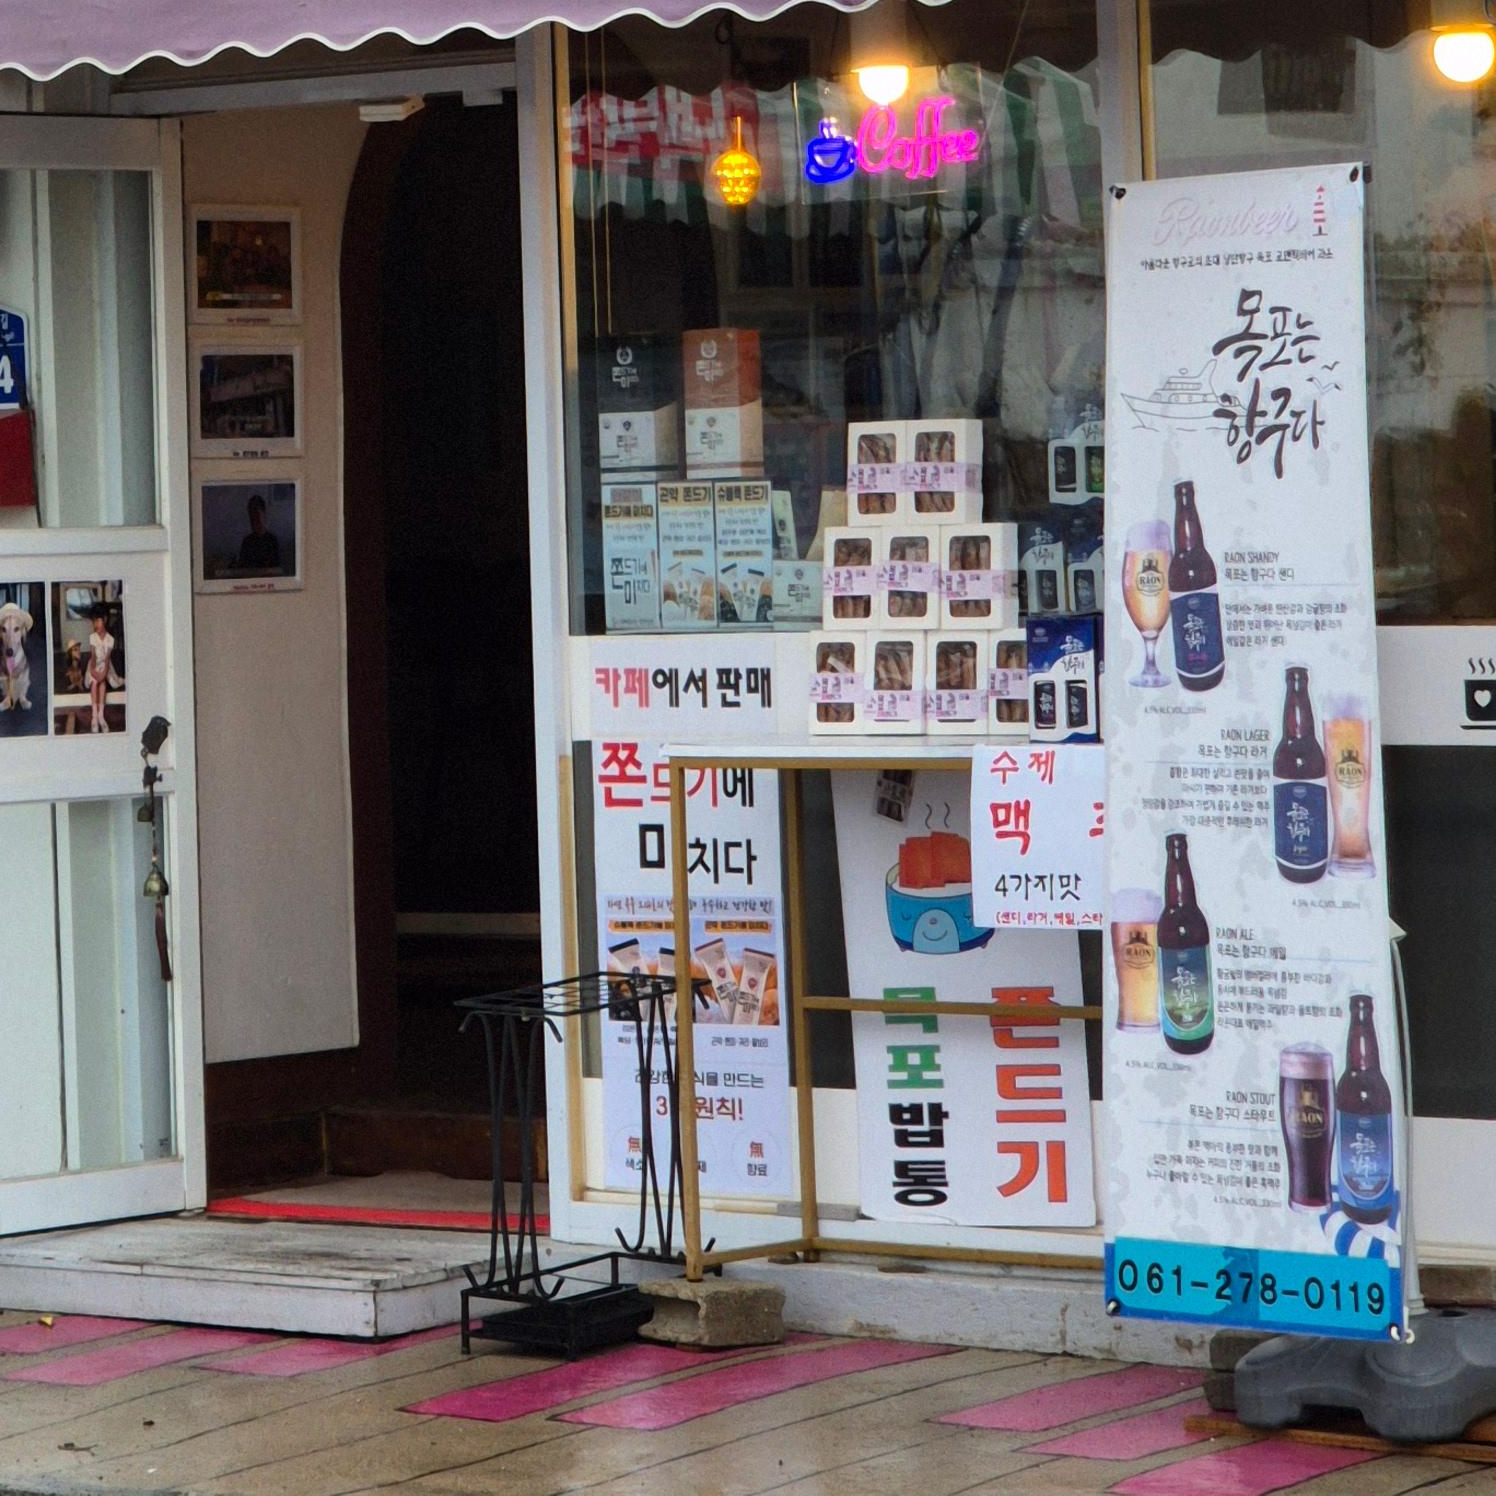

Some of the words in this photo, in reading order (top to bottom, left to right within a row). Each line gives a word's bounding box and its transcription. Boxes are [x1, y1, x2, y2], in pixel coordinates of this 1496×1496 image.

[857, 95, 985, 179] Coffee
[1212, 288, 1320, 383] 목포는
[1212, 377, 1325, 479] 항구다
[595, 667, 708, 708] 카페에서
[715, 667, 772, 709] 판매
[990, 749, 1056, 786] 수제
[994, 872, 1082, 902] 4가지맛
[1118, 1258, 1385, 1316] 061-278-0119
